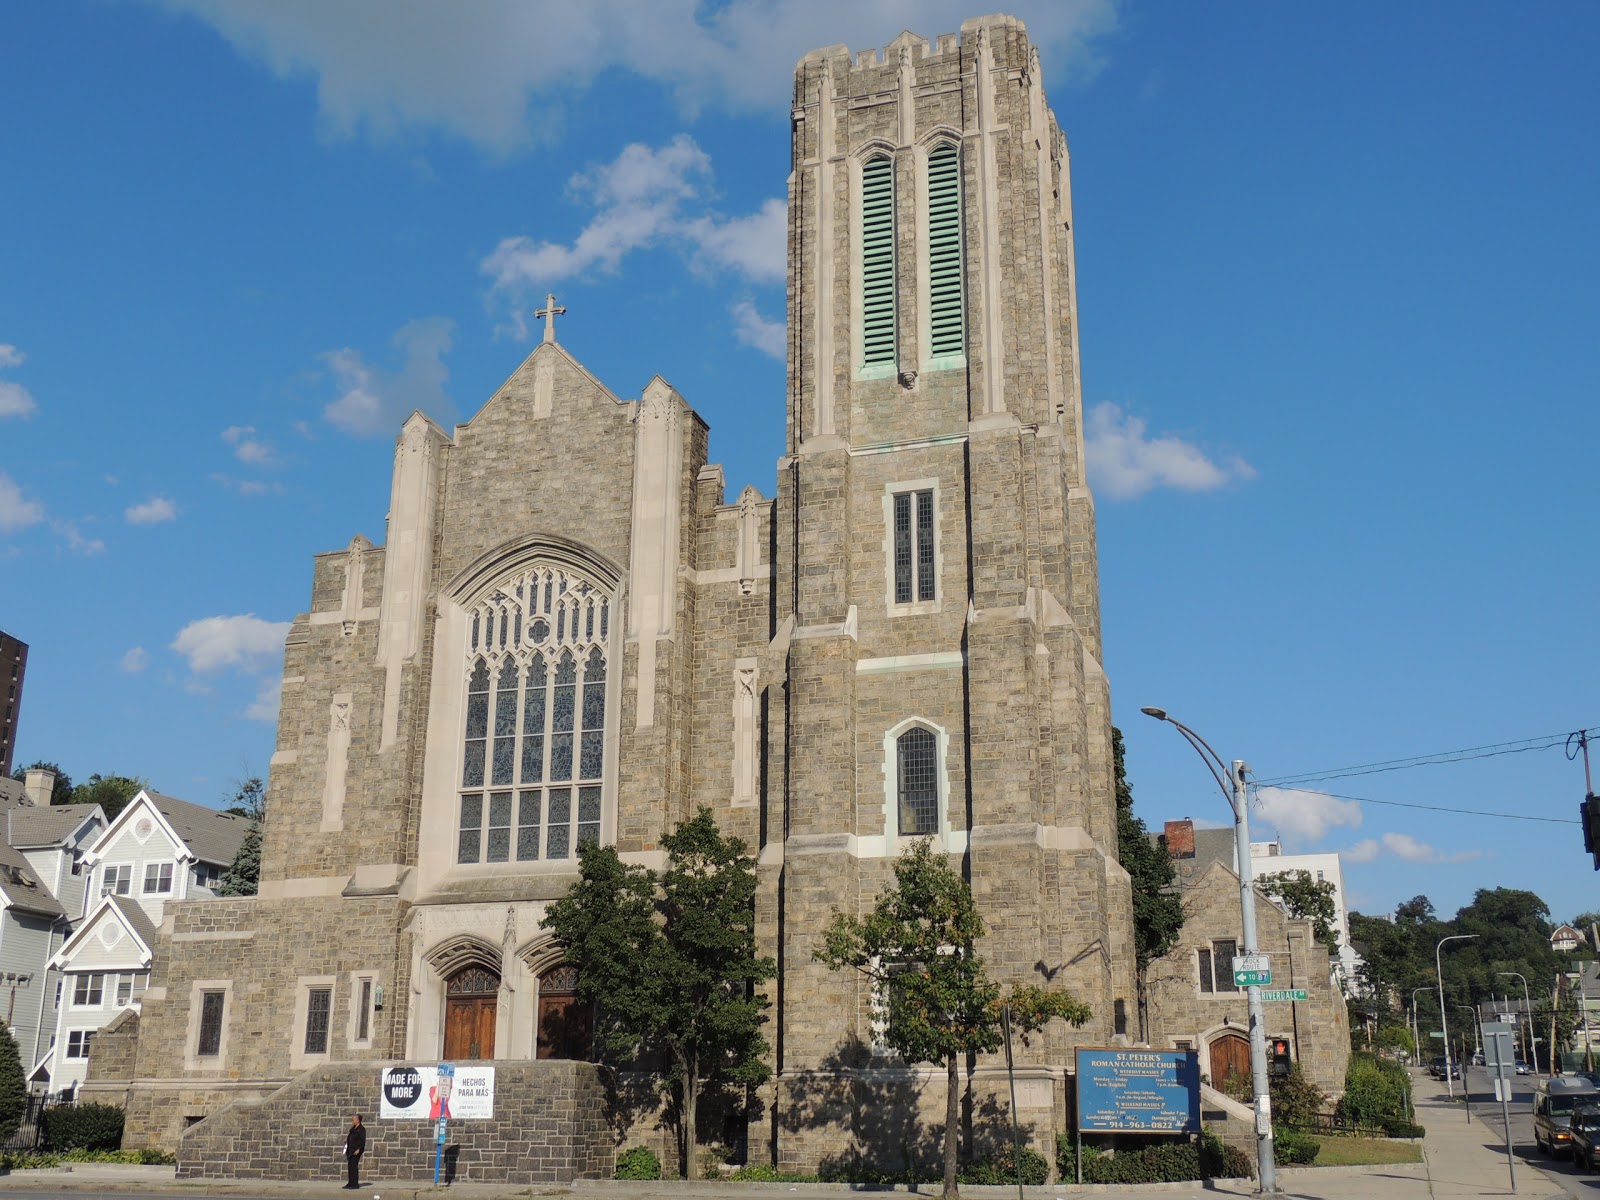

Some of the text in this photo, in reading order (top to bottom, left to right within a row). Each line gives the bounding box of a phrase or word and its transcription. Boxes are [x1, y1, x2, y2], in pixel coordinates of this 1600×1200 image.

[1262, 991, 1298, 1000] RIVERDALE
[385, 1074, 422, 1085] MADE FOR
[391, 1087, 413, 1098] MORE
[476, 1088, 489, 1096] MÁS
